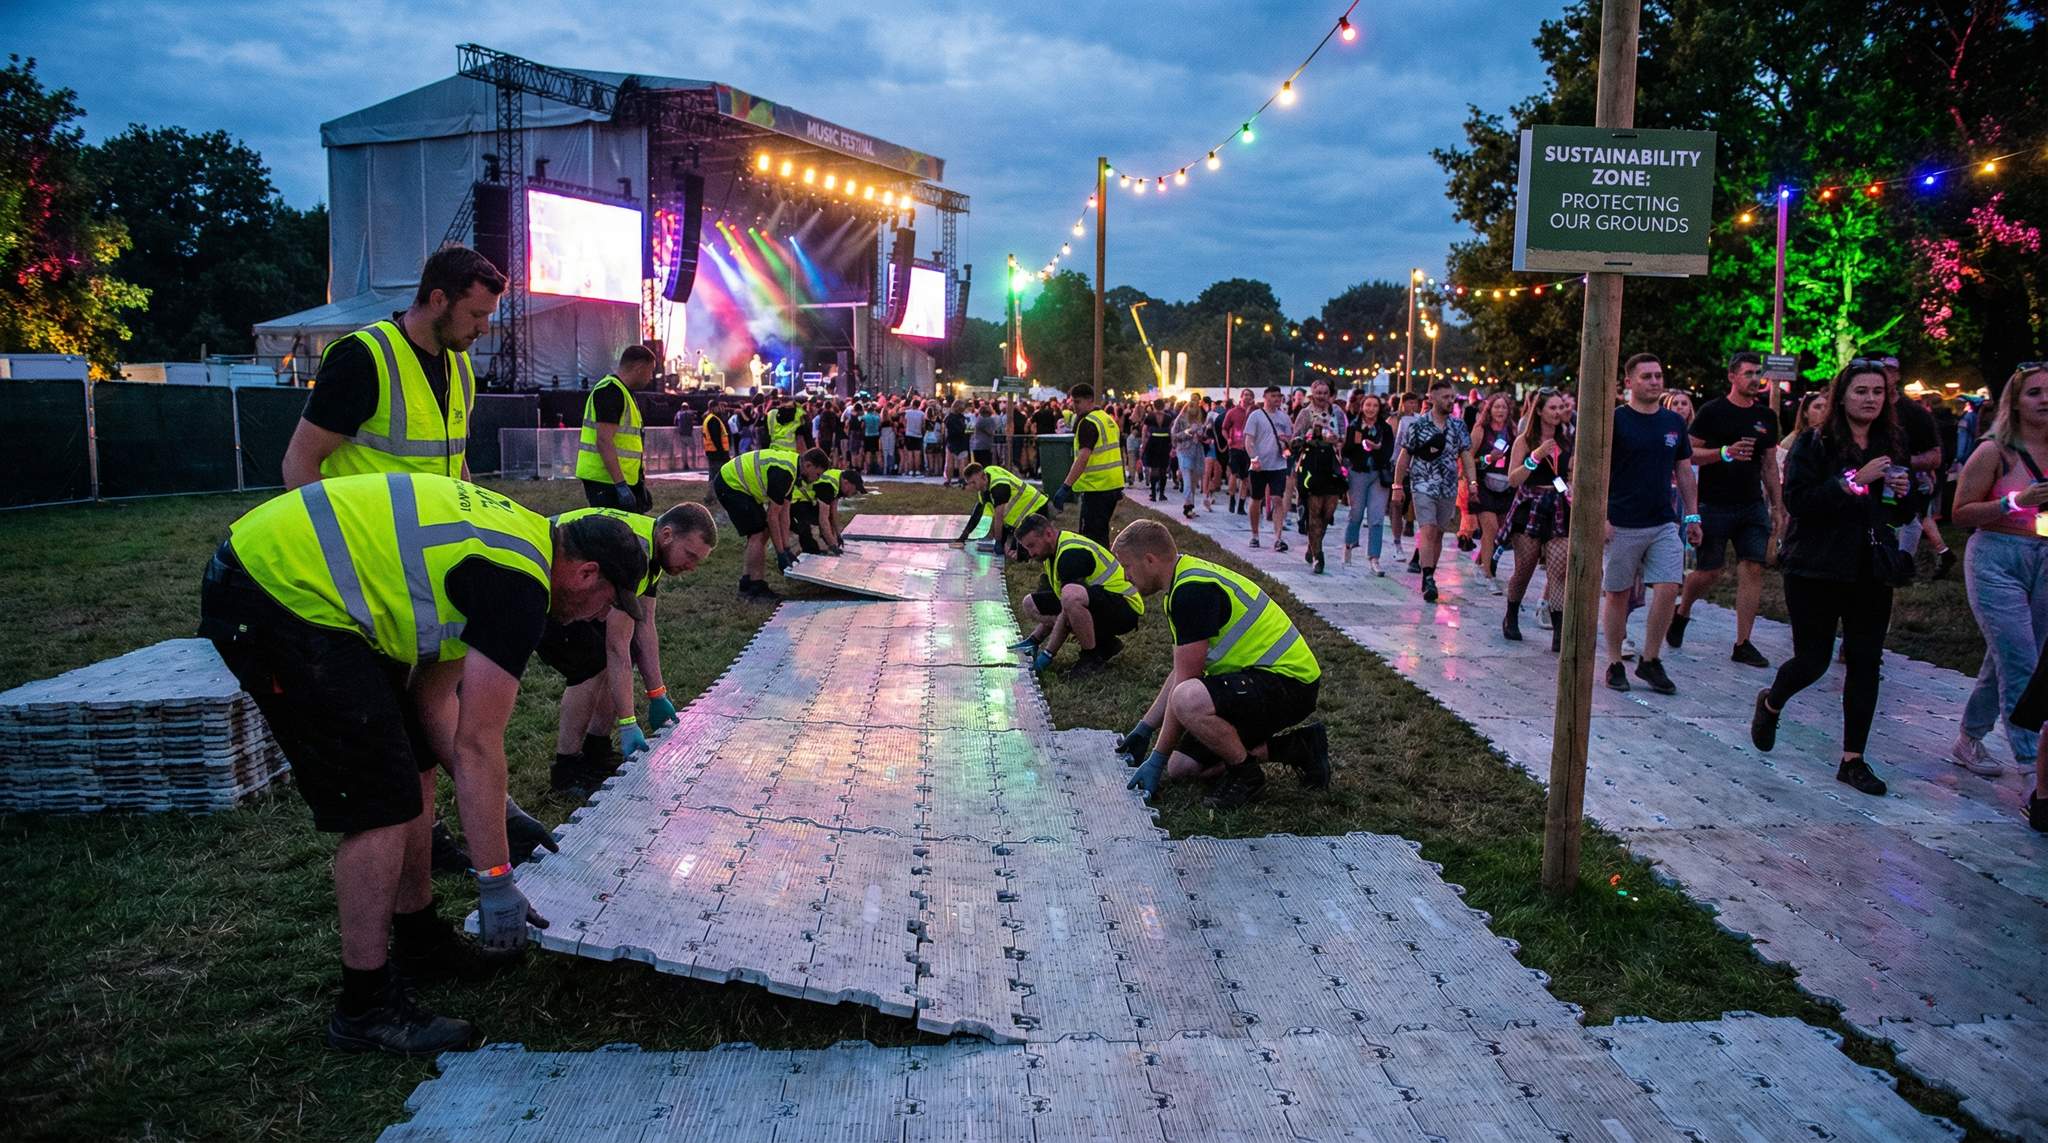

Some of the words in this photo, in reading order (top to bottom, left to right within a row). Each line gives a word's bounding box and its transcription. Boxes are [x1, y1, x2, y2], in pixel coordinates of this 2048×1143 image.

[806, 120, 840, 146] MUSIC
[1544, 145, 1702, 167] SUSTAINABILITY
[1591, 168, 1651, 187] ZONE:
[1561, 192, 1680, 213] PROTECTING
[1550, 212, 1591, 230] OUR
[1595, 214, 1689, 234] GROUNDS
